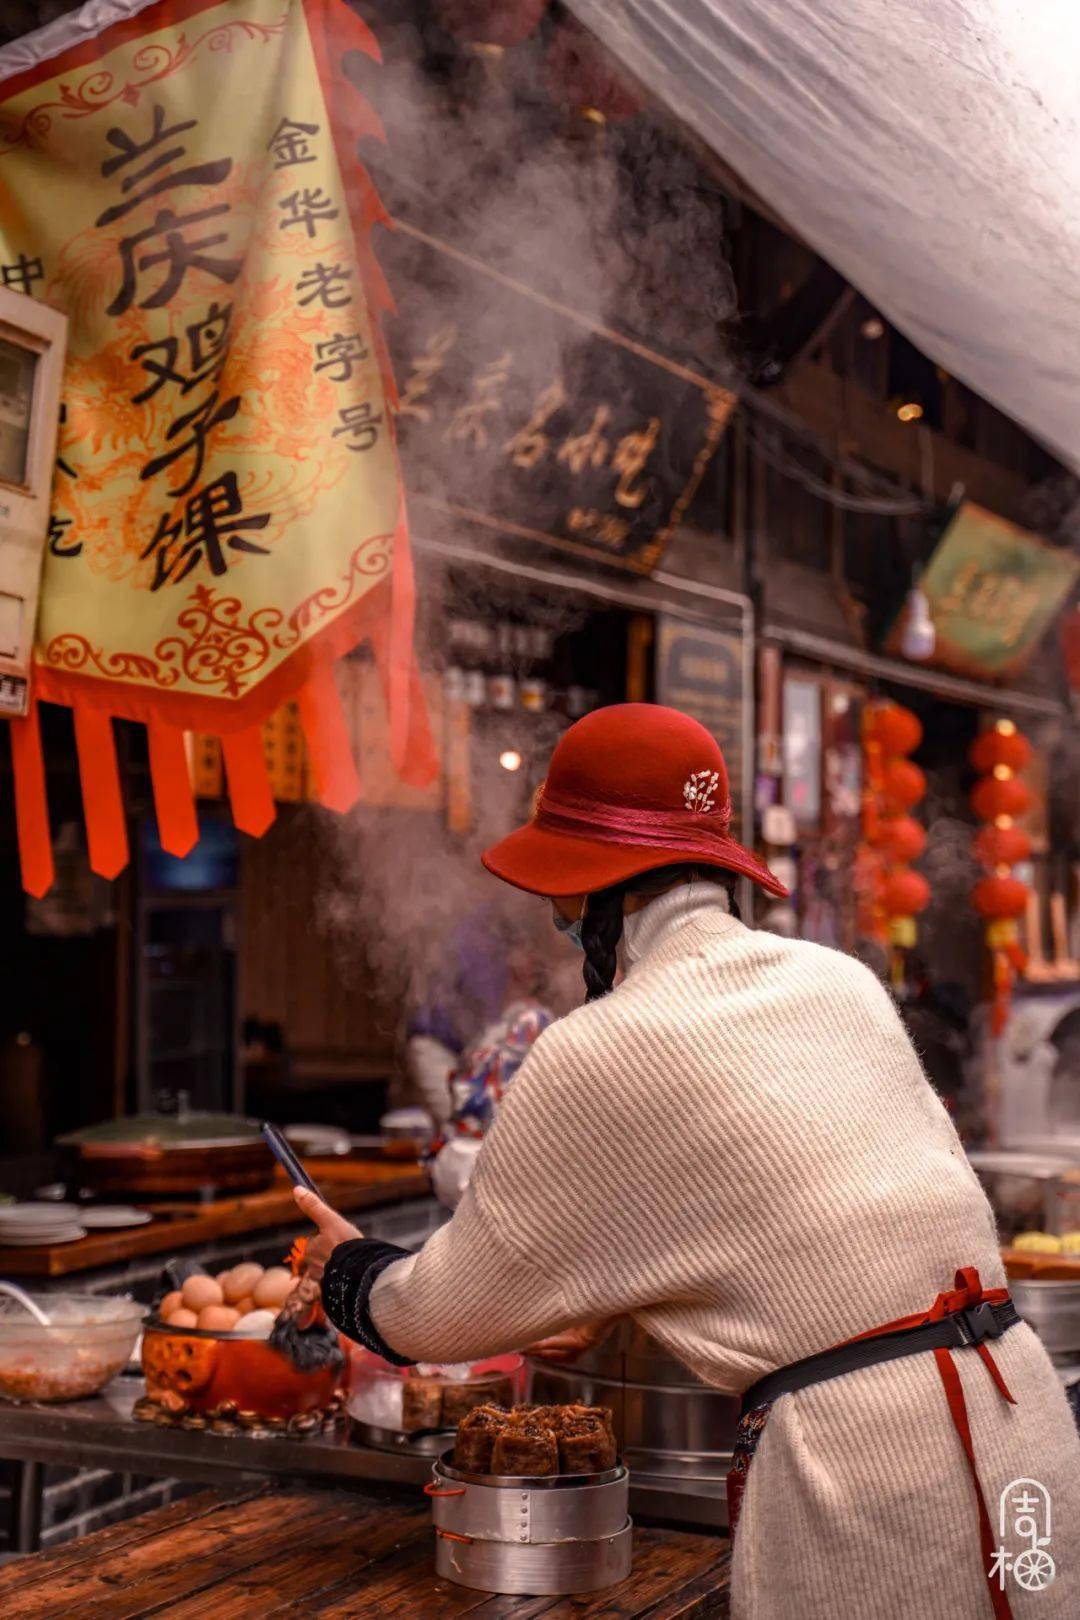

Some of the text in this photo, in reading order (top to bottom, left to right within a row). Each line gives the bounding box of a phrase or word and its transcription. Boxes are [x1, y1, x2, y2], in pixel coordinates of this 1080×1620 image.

[267, 117, 384, 452] 金华老字号
